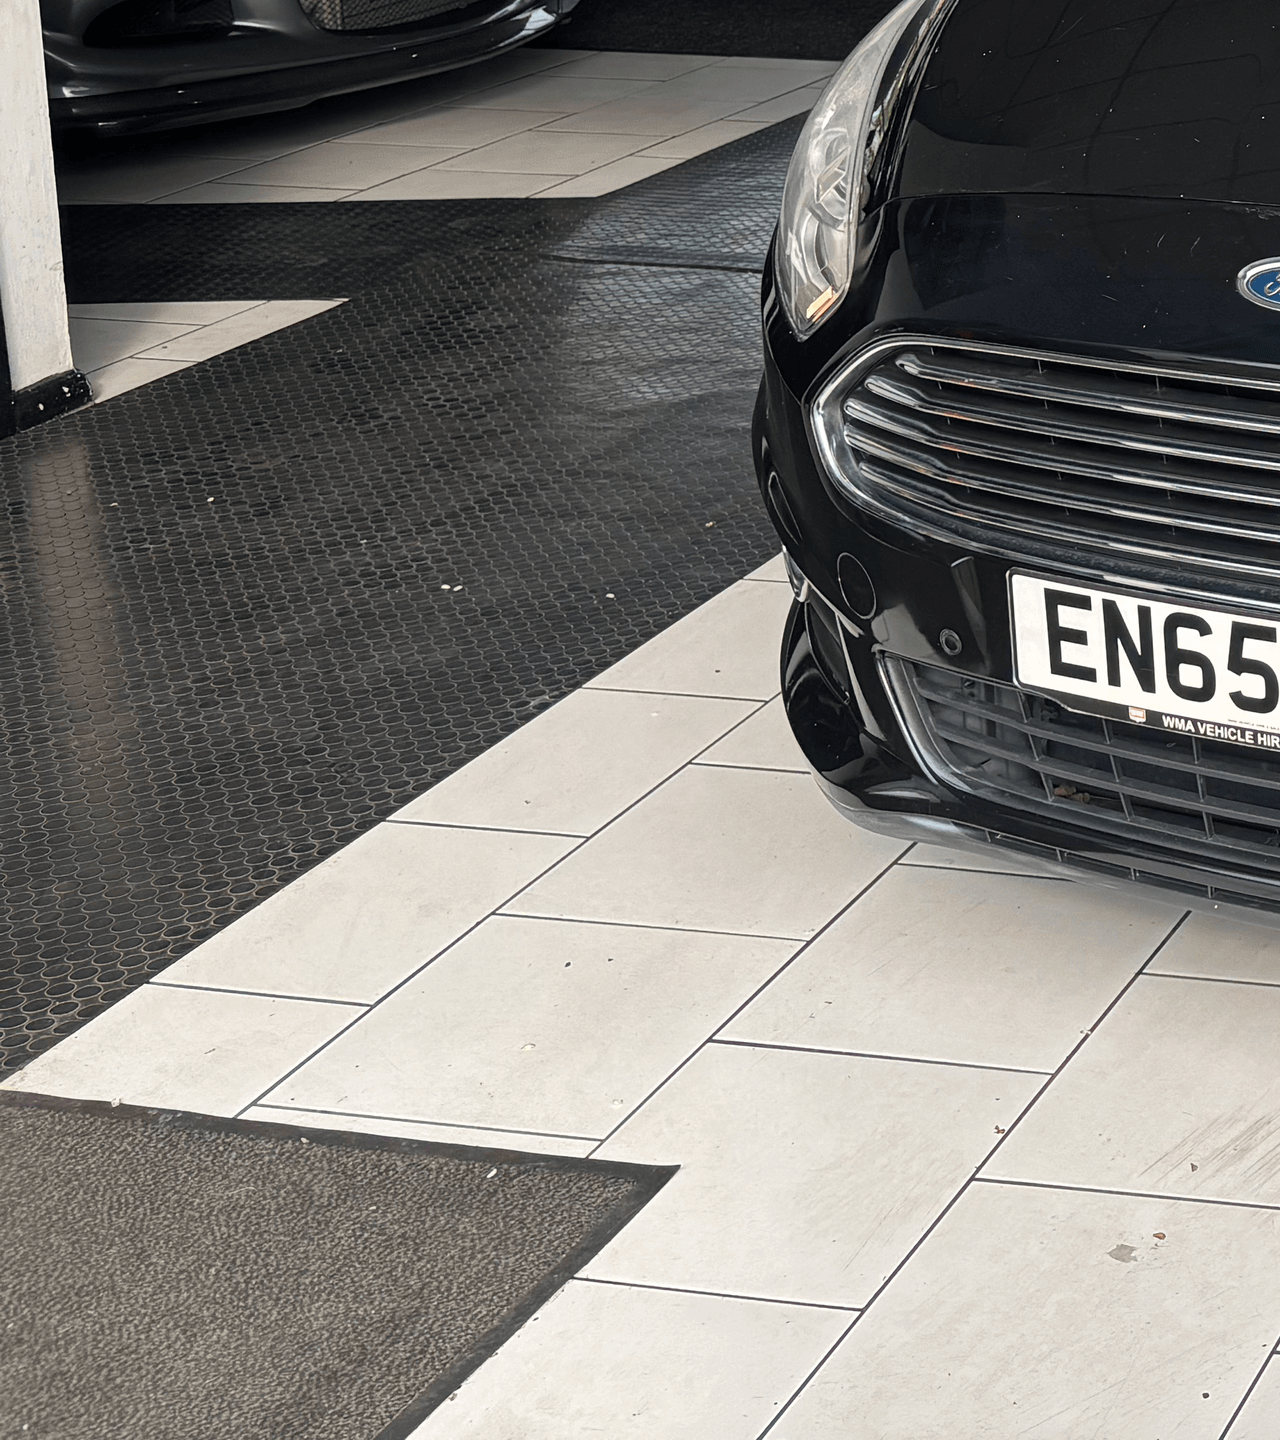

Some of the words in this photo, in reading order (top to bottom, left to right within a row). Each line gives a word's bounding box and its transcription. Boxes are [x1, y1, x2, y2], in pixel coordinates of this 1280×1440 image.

[1044, 587, 1279, 715] EN65
[1161, 714, 1196, 733] WMA
[1197, 721, 1254, 744] VEHICLE
